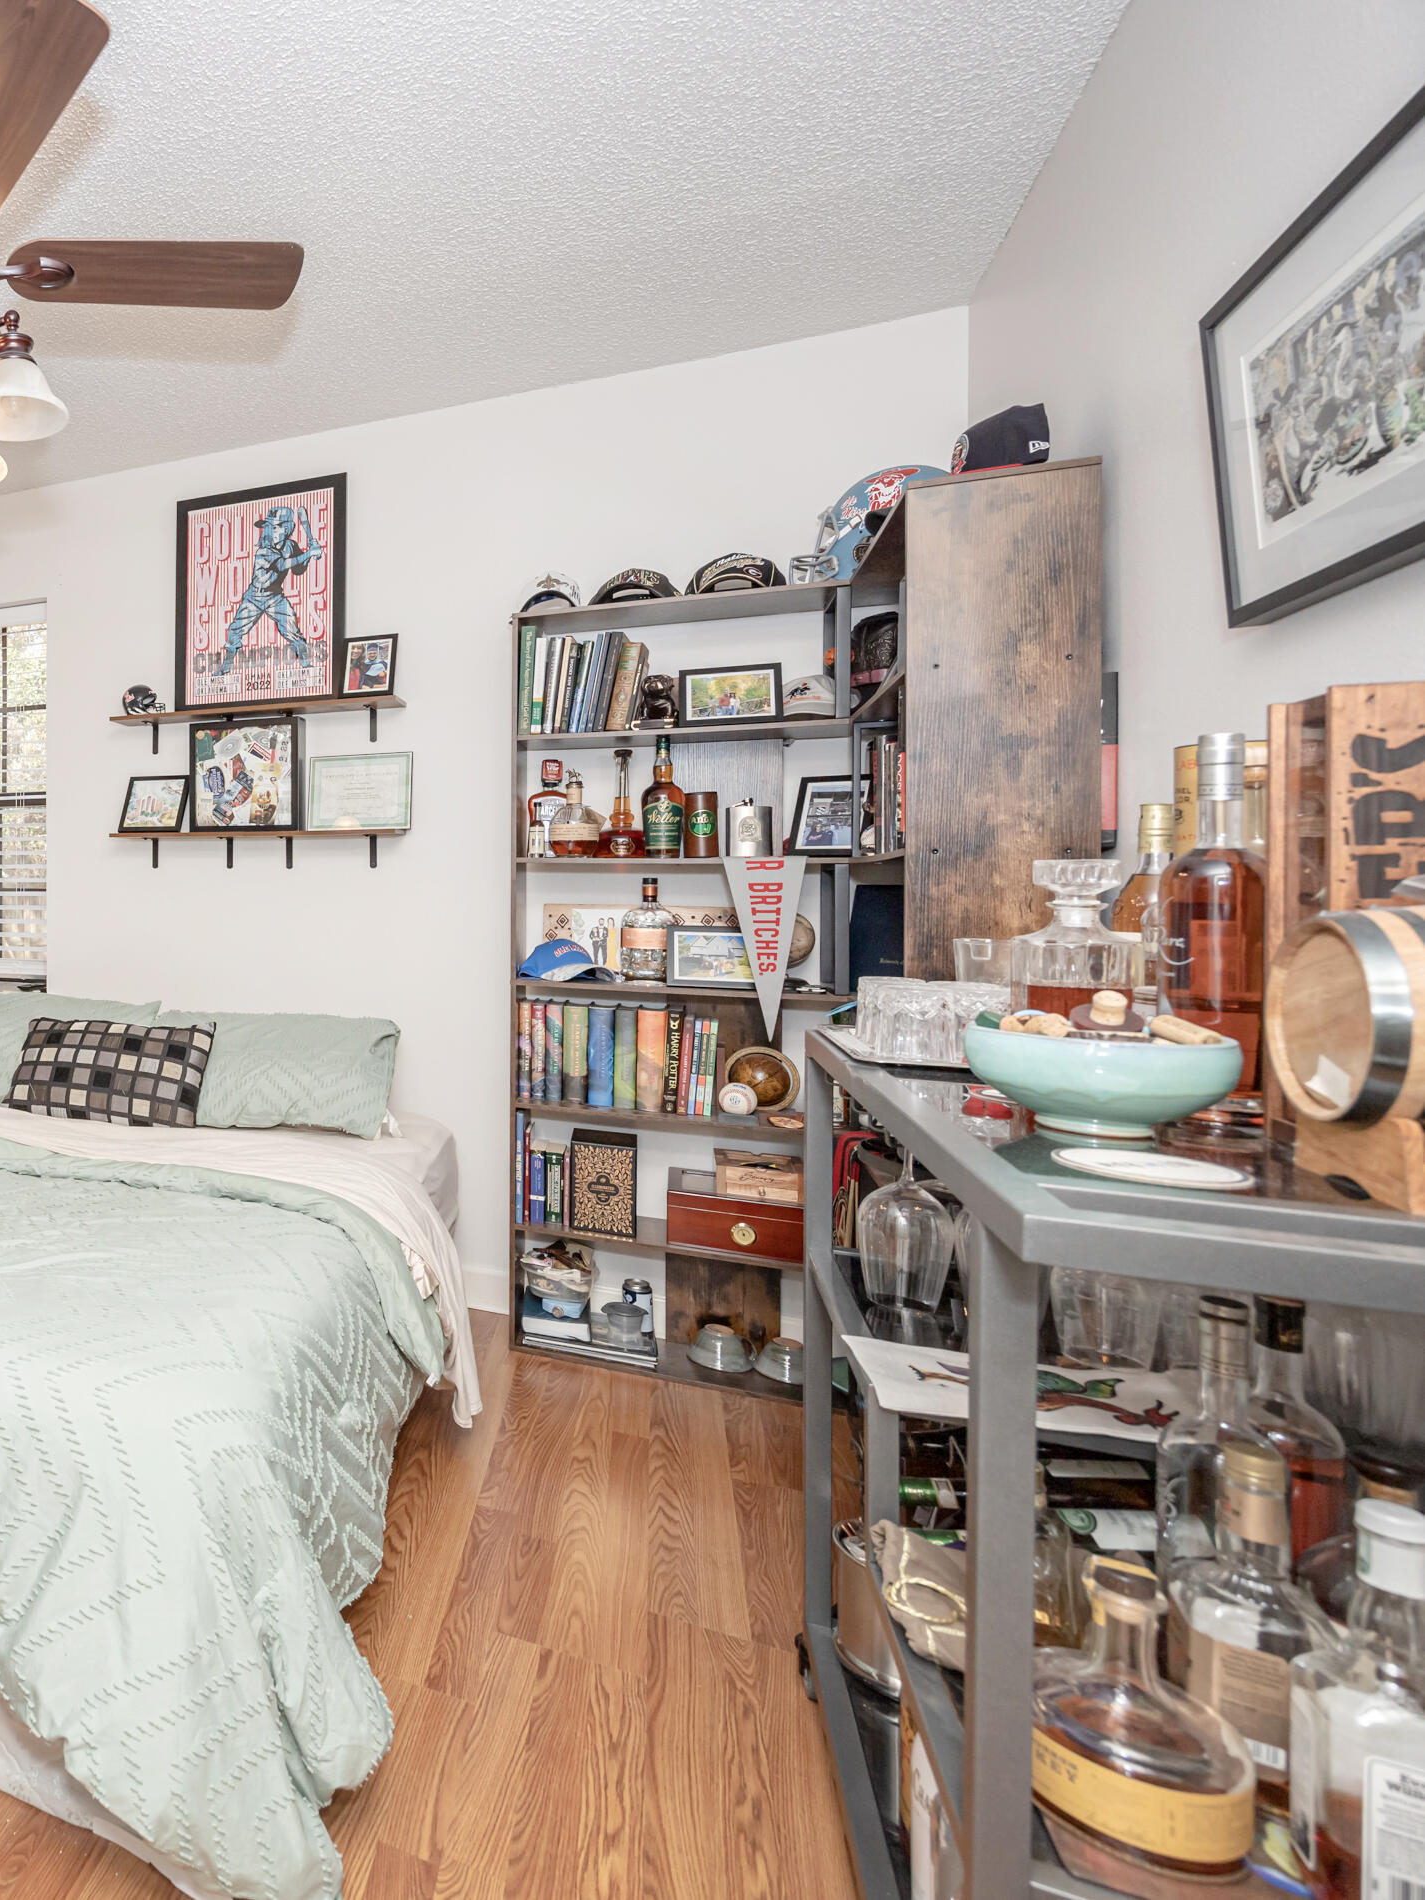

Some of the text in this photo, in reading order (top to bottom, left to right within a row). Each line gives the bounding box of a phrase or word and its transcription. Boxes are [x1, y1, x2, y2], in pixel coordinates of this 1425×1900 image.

[246, 681, 271, 691] 2022
[647, 809, 681, 824] Weller
[553, 945, 570, 957] OLE
[669, 1032, 680, 1089] HARRY POTTER
